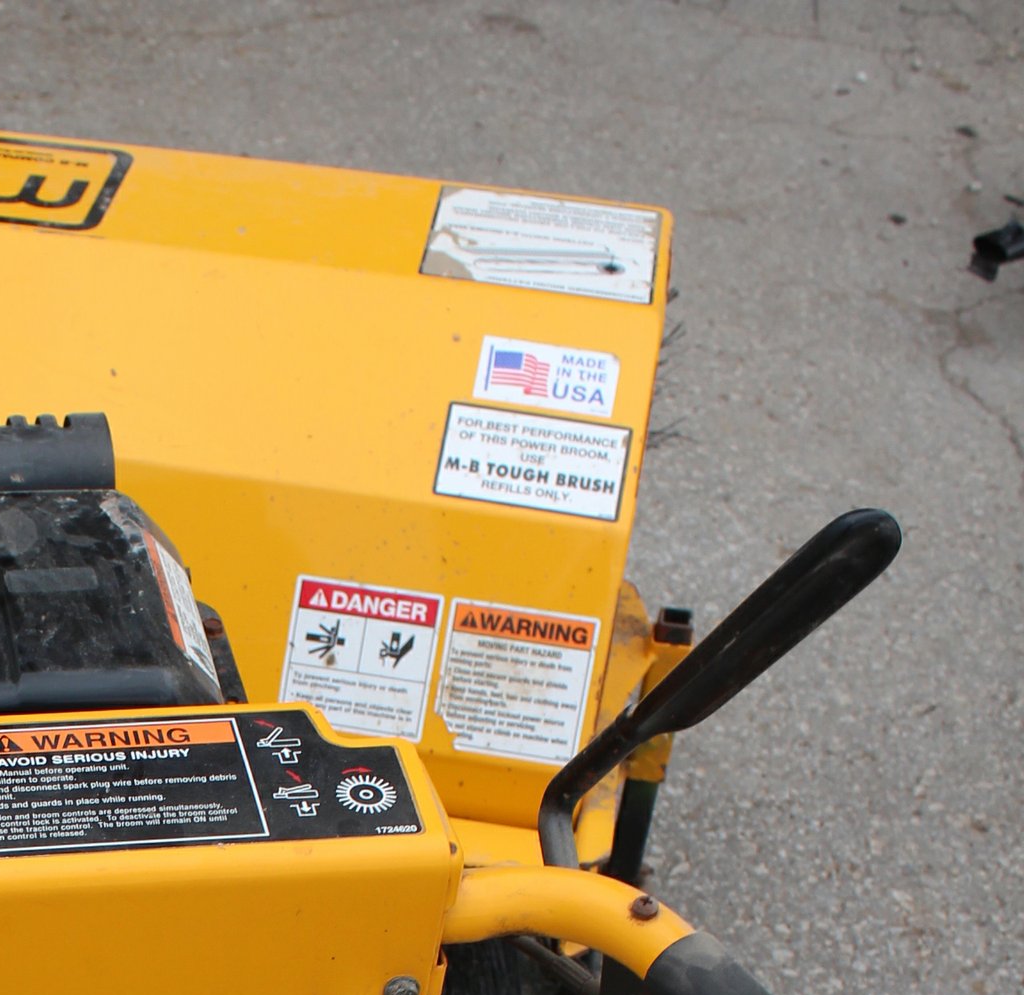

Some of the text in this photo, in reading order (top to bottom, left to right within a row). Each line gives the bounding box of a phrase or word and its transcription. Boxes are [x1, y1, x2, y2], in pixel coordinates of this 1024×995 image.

[562, 354, 606, 370] MADE
[557, 366, 607, 383] IN THE
[552, 381, 604, 406] USA
[458, 416, 618, 449] FOR BEST PERFORMANCE
[459, 430, 476, 440] OF
[480, 433, 508, 445] THIS
[510, 438, 556, 453] POWER
[520, 453, 545, 464] USE
[444, 456, 615, 494] M-B TOUGH BRUSH
[481, 479, 532, 495] REFILLS
[331, 590, 428, 621] DANGER
[480, 612, 589, 644] WARNING
[31, 728, 190, 750] WARNING
[52, 751, 126, 764] SERIOUS
[130, 748, 190, 760] INJURY
[0, 769, 32, 777] Manual
[34, 766, 62, 775] before
[65, 765, 107, 774] operating
[110, 764, 130, 772] unit.
[12, 784, 60, 793] disconnect
[63, 782, 88, 791] spark
[90, 781, 110, 790] plug
[134, 778, 162, 786] before
[165, 776, 207, 784] removing
[210, 774, 237, 782] debris
[40, 774, 77, 784] operate.
[31, 800, 62, 809] guards
[76, 798, 100, 806] place
[128, 794, 166, 802] running.
[0, 820, 30, 828] control
[62, 816, 102, 824] activated.
[119, 813, 160, 821] deactivate
[208, 808, 237, 816] control
[114, 806, 156, 814] depressed
[26, 825, 58, 833] traction
[61, 823, 93, 831] control.
[49, 830, 87, 838] released.
